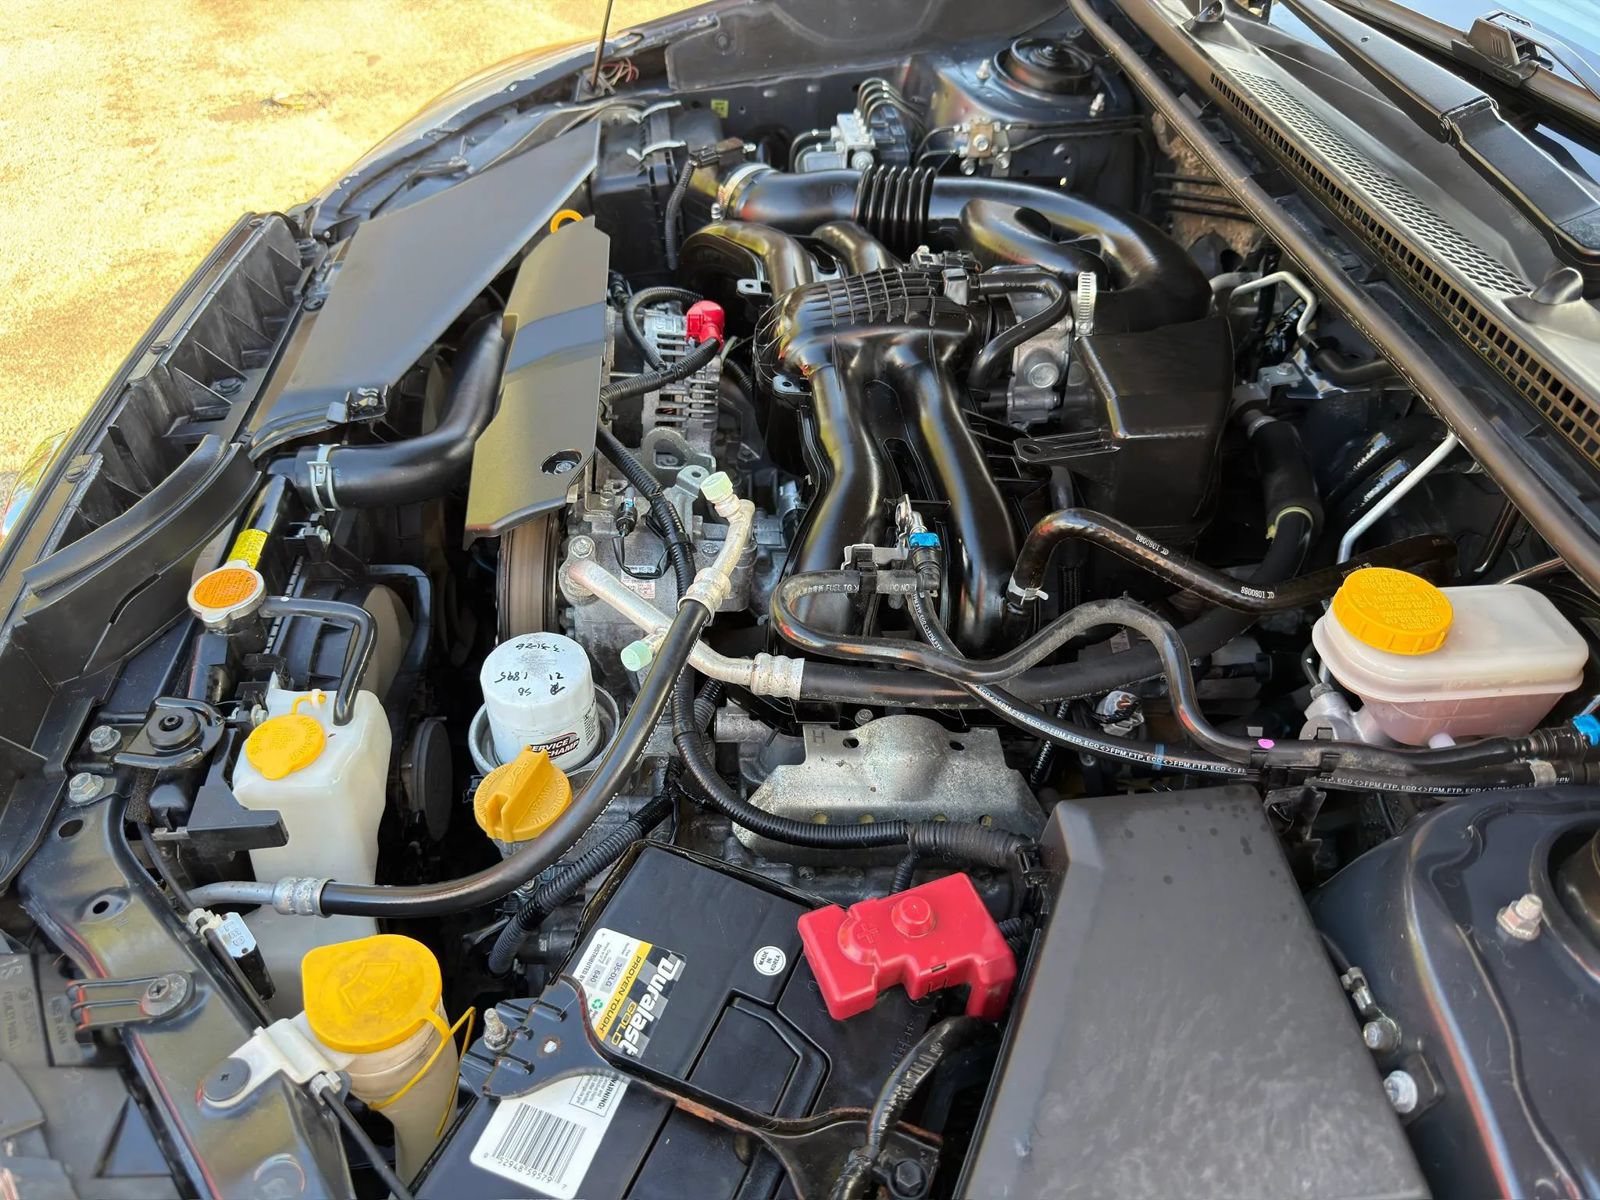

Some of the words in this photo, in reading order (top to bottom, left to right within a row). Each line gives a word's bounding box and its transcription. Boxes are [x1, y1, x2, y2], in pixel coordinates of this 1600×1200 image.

[531, 738, 570, 752] ERVICE
[548, 739, 579, 757] HAMP
[758, 951, 769, 965] MADE
[770, 955, 781, 971] KOREA
[618, 956, 642, 996] PROVEN
[599, 997, 621, 1033] TOUGH
[618, 957, 682, 1056] Duralast
[611, 1001, 637, 1045] GOLD
[497, 1157, 524, 1173] 52948
[526, 1167, 553, 1184] 59579
